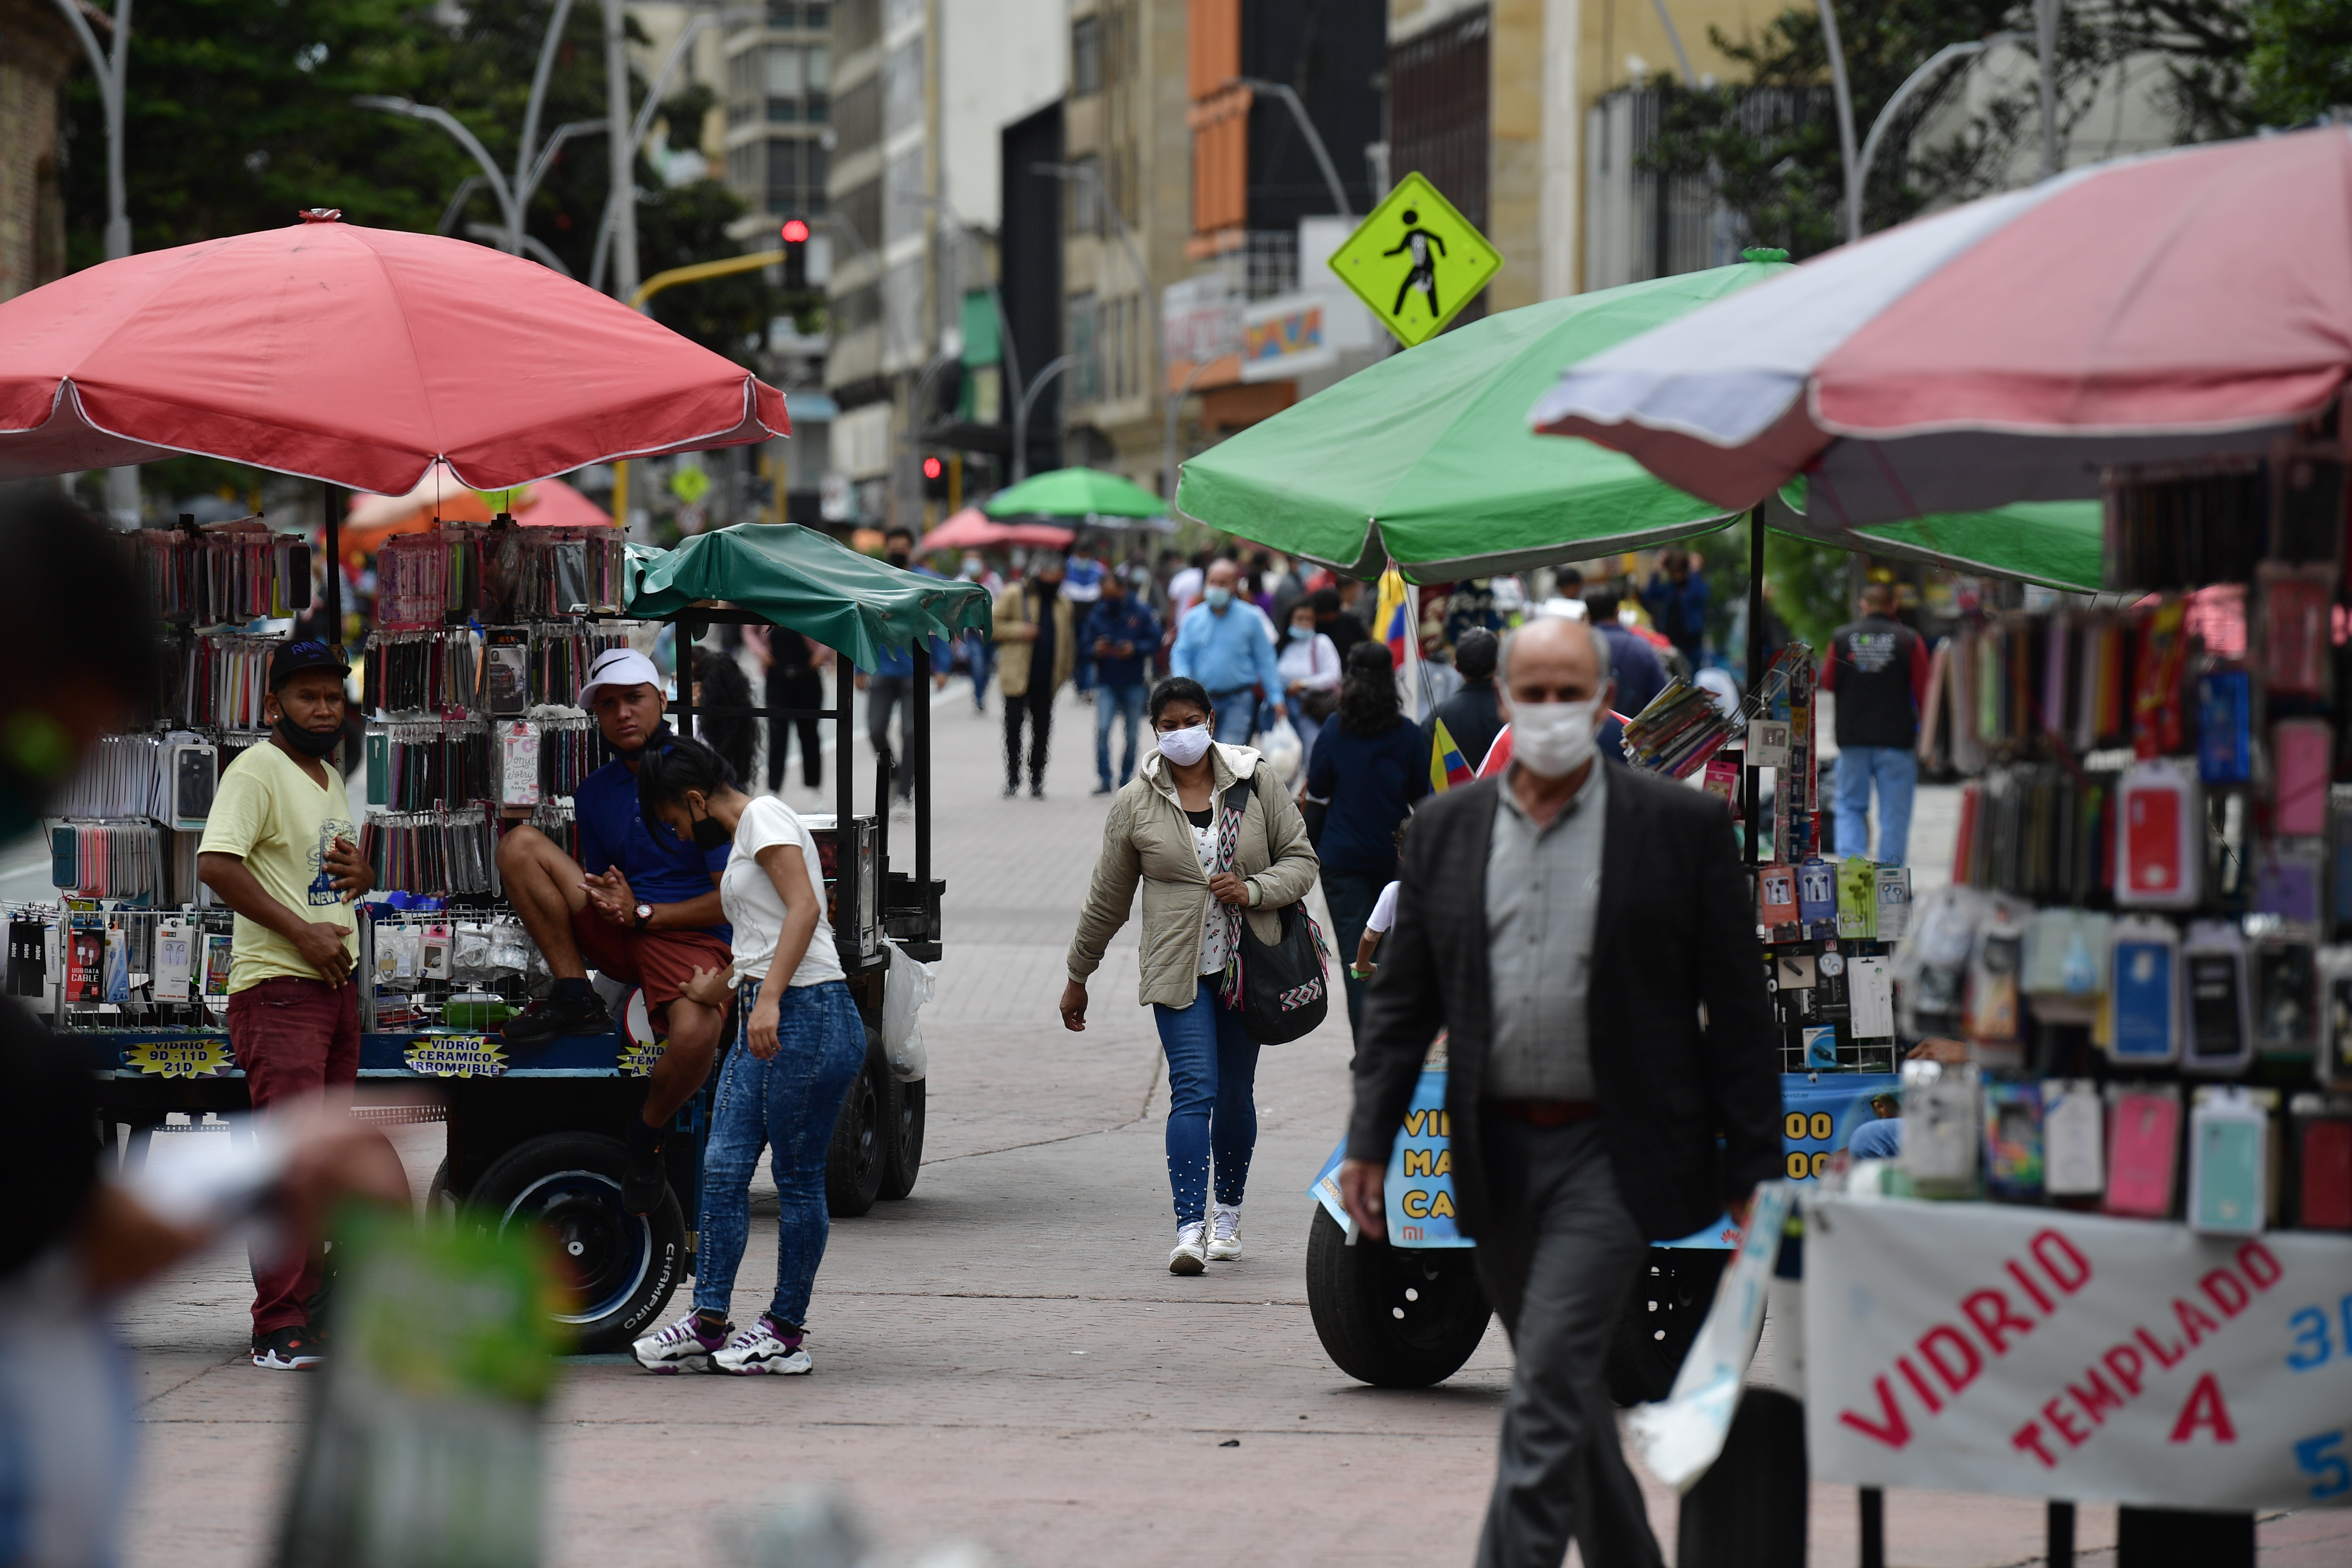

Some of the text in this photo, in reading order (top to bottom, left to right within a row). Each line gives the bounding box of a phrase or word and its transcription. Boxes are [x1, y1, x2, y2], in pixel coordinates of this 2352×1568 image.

[310, 890, 335, 904] NEW
[71, 973, 99, 982] CABLE
[431, 1040, 480, 1051] VIDRIO
[643, 1046, 667, 1055] VID
[150, 1051, 169, 1060] 9D
[418, 1051, 492, 1062] CERAMICO
[164, 1062, 192, 1072] 21D
[411, 1061, 498, 1073] IRROMPIBLE
[632, 1066, 641, 1075] A
[1784, 1111, 1832, 1140] 00
[1402, 1190, 1455, 1219] CA
[624, 1243, 675, 1329] CHAMPIRO
[1838, 1228, 2093, 1451] VIDRIO
[2010, 1240, 2285, 1470] TEMPLADO
[2167, 1372, 2239, 1445] A
